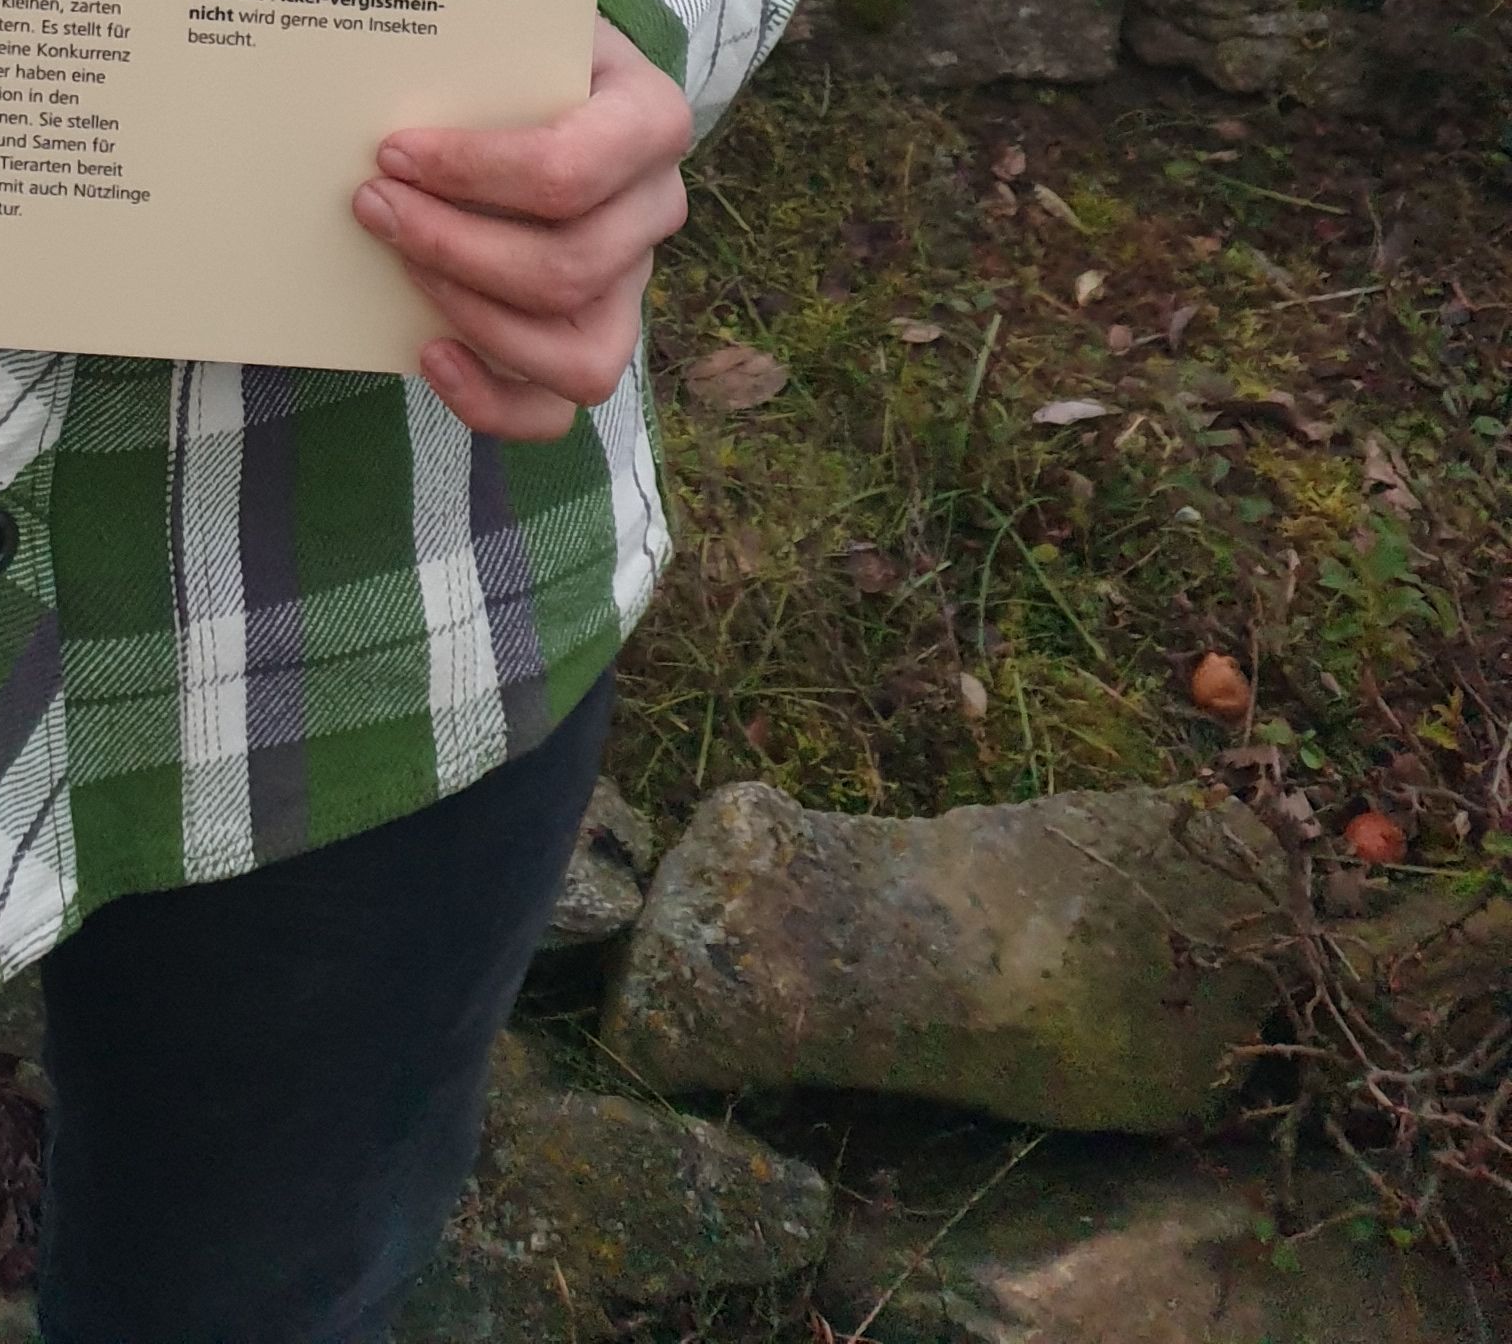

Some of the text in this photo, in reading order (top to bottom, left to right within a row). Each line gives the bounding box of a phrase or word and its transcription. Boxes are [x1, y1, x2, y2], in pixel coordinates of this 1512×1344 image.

[69, 0, 122, 16] zarten
[41, 19, 59, 36] Es
[63, 21, 103, 38] stellt
[106, 22, 132, 40] für
[188, 5, 438, 36] nicht wird gerne von Insekten
[187, 27, 257, 48] besucht.
[36, 42, 132, 63] Konkurrenz
[15, 63, 67, 82] haben
[71, 68, 107, 85] eine
